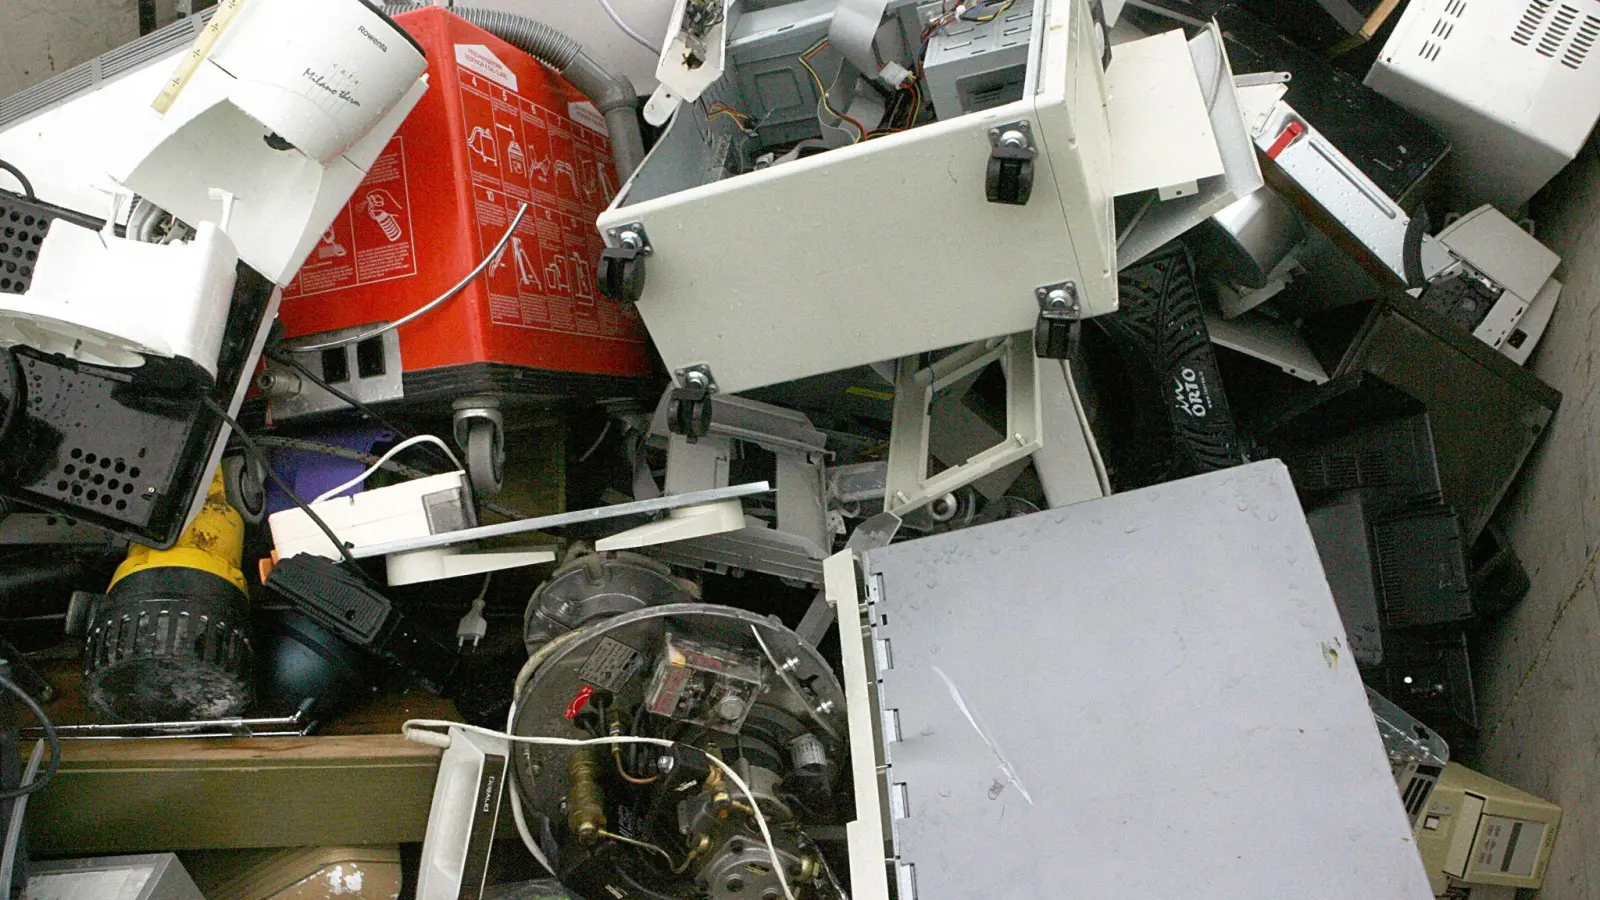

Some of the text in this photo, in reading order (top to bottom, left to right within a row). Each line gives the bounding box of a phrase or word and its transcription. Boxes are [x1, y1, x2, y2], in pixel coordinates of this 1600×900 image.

[358, 25, 388, 53] Rowenta
[302, 67, 337, 95] Milano
[471, 76, 478, 88] 4
[502, 89, 508, 102] 5
[531, 104, 537, 115] 6
[486, 190, 495, 202] 10
[545, 209, 552, 220] 12
[1181, 368, 1206, 417] ORTO
